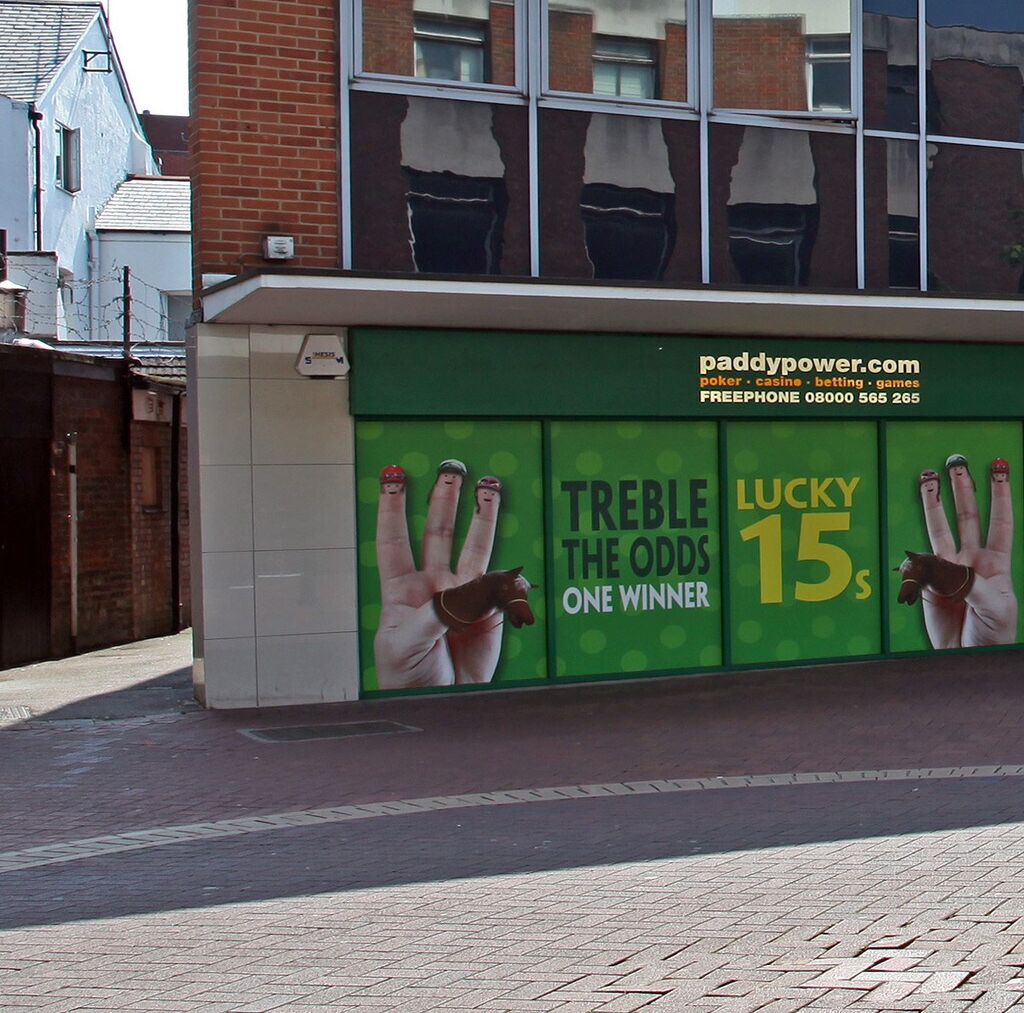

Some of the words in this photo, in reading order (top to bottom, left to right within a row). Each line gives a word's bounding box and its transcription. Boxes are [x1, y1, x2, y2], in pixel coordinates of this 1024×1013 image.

[699, 352, 920, 376] paddypower.com
[700, 376, 742, 388] poker
[756, 377, 802, 387] casino
[815, 376, 864, 389] betting
[876, 378, 920, 390] games
[700, 390, 800, 403] FREEPHONE
[805, 392, 854, 404] 08000
[859, 392, 888, 404] 565
[892, 392, 920, 404] 265
[561, 479, 708, 532] TREBLE
[737, 477, 860, 510] LUCKY
[562, 538, 619, 580] THE
[629, 535, 711, 578] ODDS
[562, 586, 613, 615] ONE
[619, 581, 710, 612] WINNER
